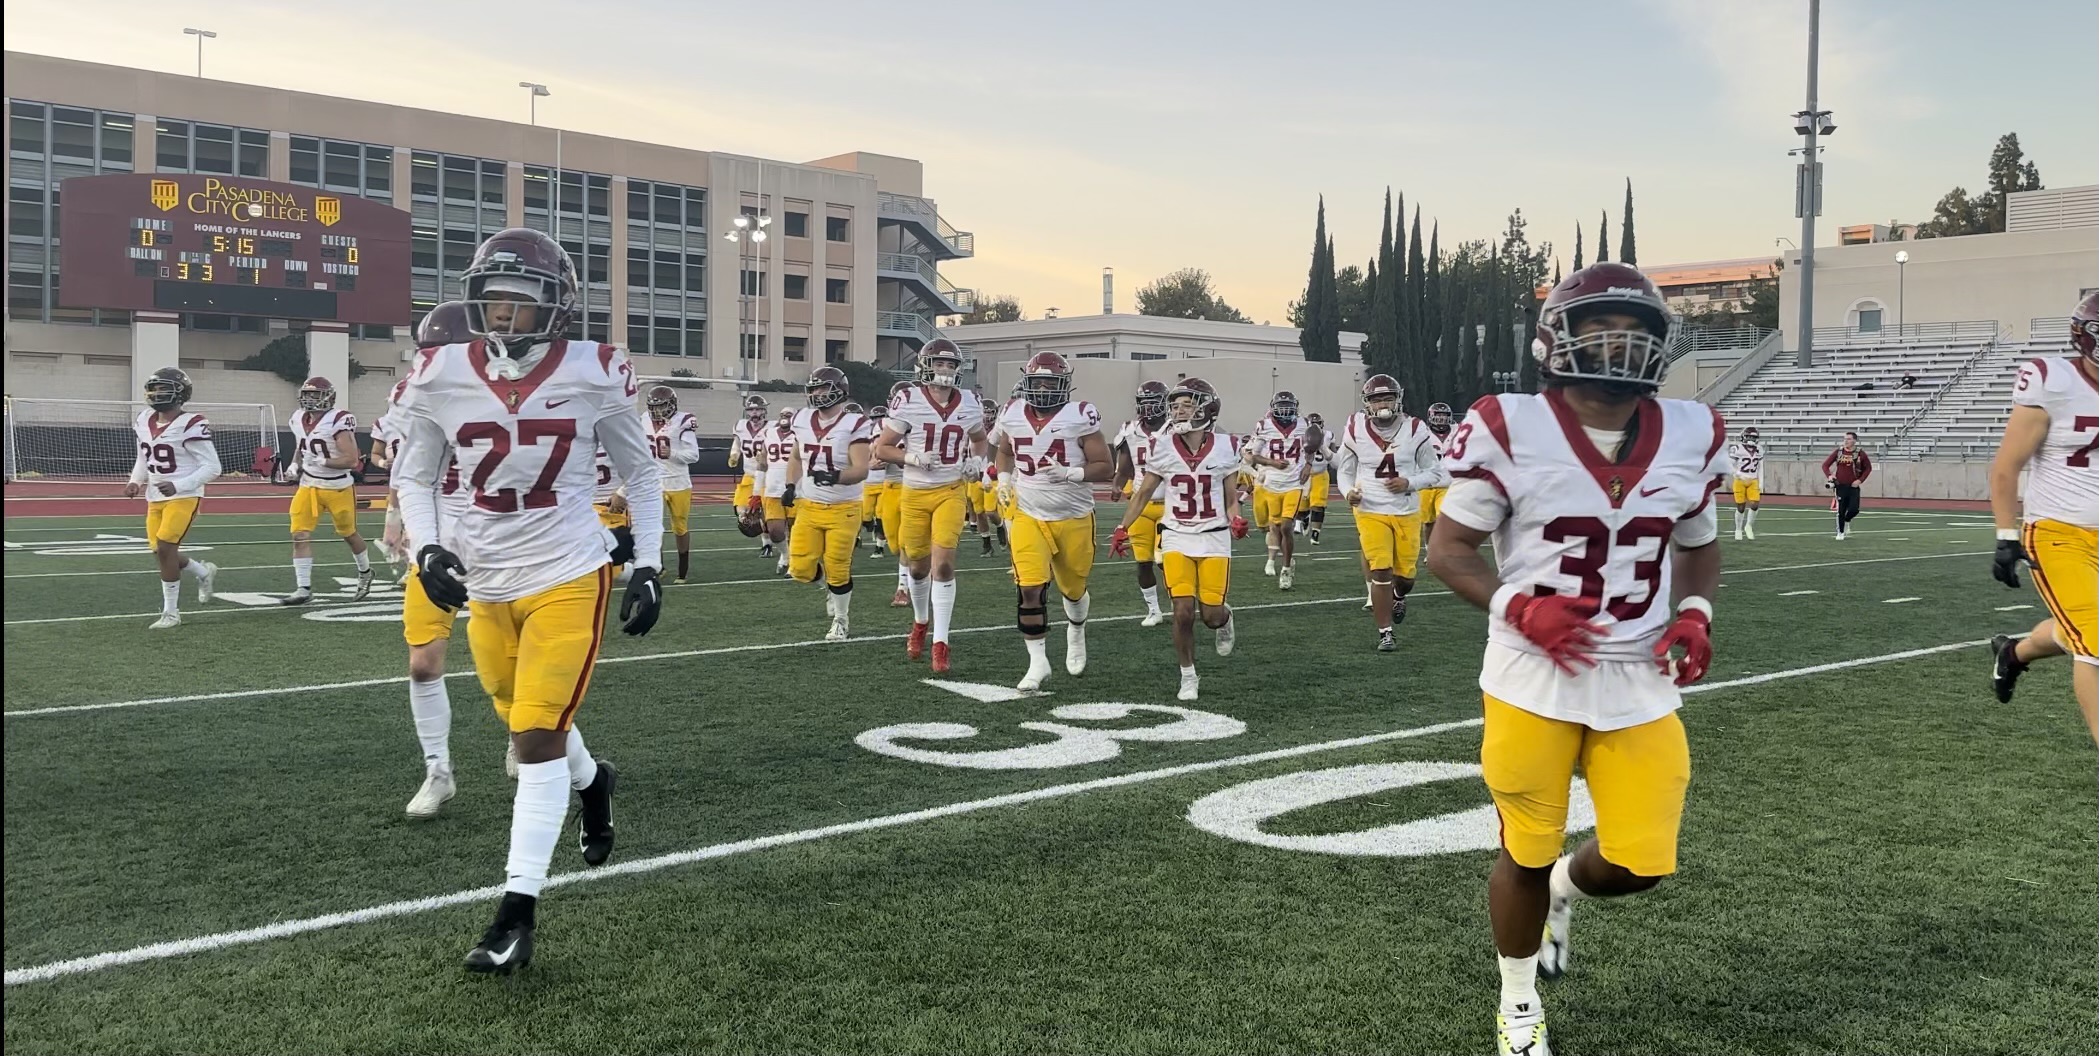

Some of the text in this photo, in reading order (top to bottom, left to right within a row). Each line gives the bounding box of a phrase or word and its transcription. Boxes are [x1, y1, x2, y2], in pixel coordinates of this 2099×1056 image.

[187, 192, 232, 215] CITY
[206, 178, 296, 207] PASADENA
[138, 218, 166, 231] HOME
[194, 223, 302, 240] HOME OF THE LANCERS
[142, 229, 154, 247] 0
[213, 235, 254, 255] 5:15
[321, 234, 357, 247] GUESTS
[229, 256, 267, 269] PERIOD
[284, 259, 308, 272] DOWN
[348, 247, 359, 263] 0
[618, 359, 639, 398] 2
[768, 443, 794, 463] 95
[923, 422, 964, 465] 10
[1269, 438, 1301, 464] 84
[140, 441, 178, 474] 29
[456, 418, 577, 513] 27
[804, 443, 836, 477] 71
[1013, 437, 1070, 477] 54
[1374, 453, 1400, 480] 4
[1740, 457, 1760, 473] 23
[1170, 474, 1218, 520] 31
[1534, 516, 1677, 622] 33
